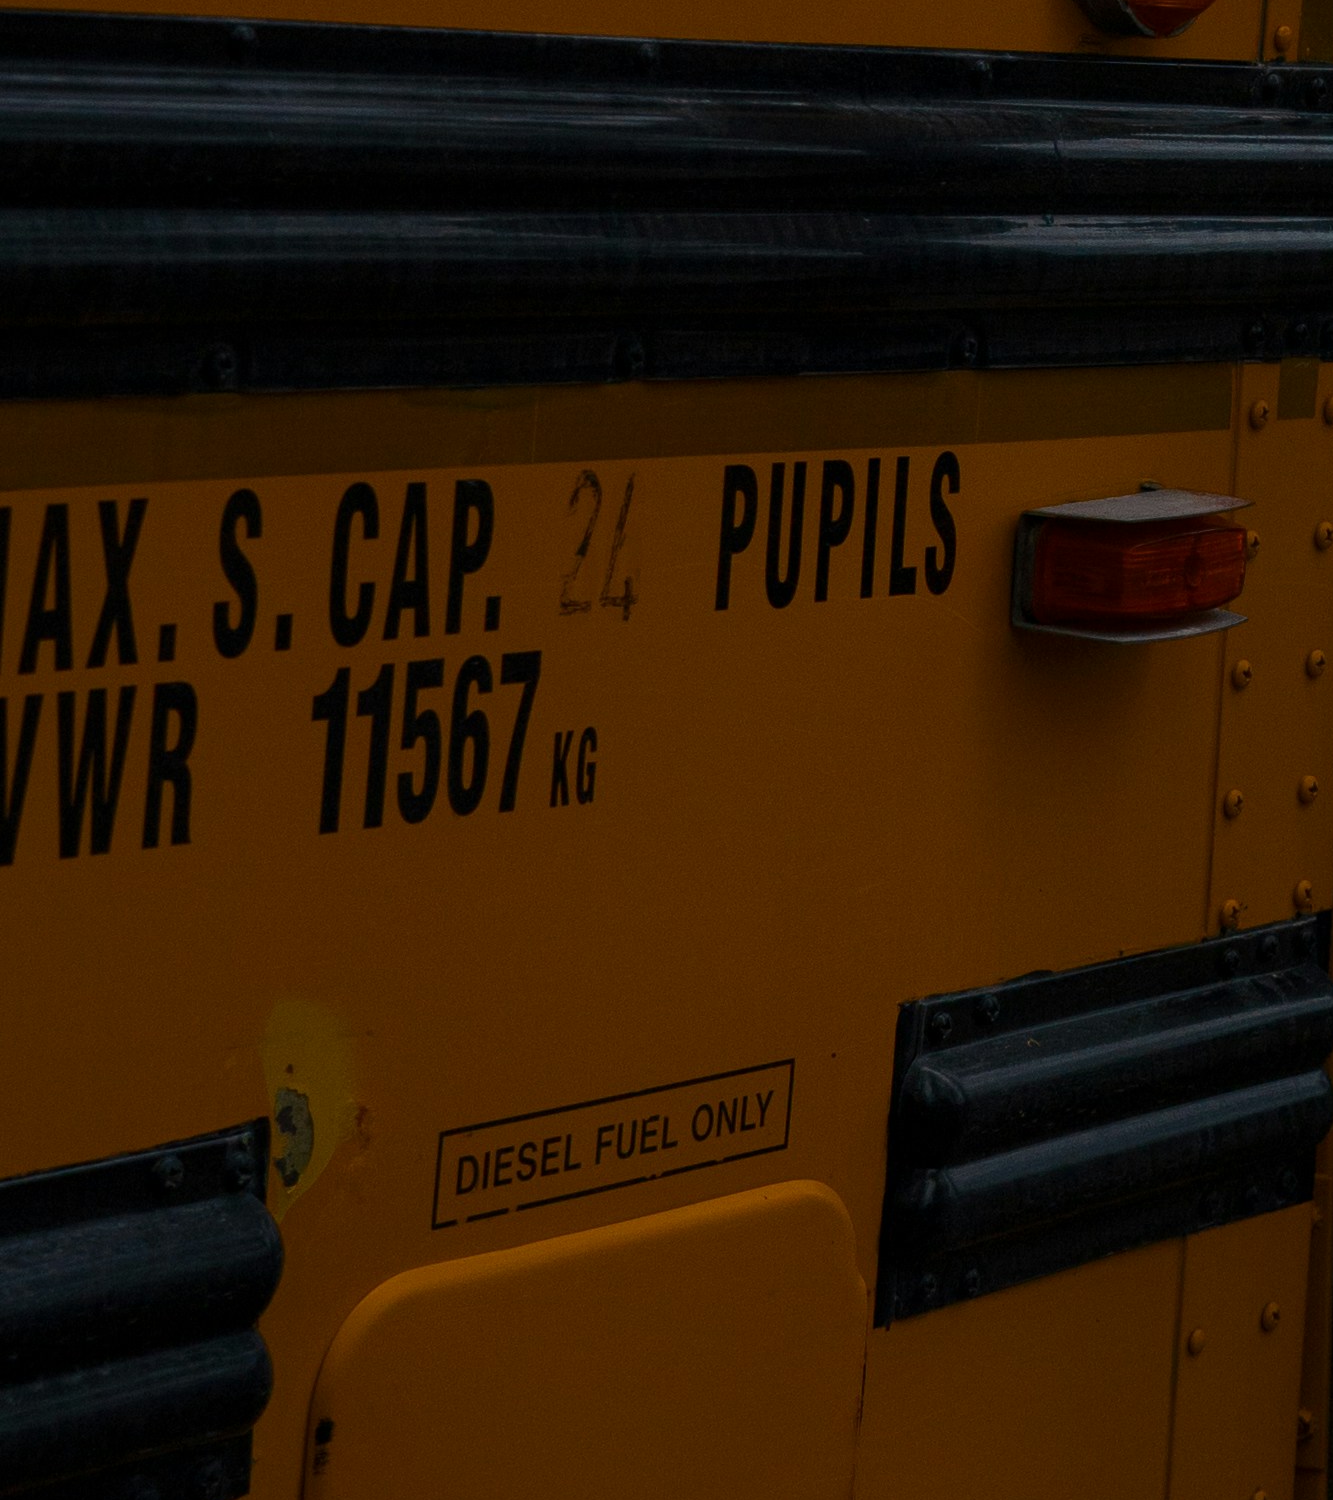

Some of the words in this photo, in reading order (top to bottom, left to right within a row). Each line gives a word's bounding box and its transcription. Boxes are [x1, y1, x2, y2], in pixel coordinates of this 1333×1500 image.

[0, 498, 177, 674] AX.
[213, 487, 293, 659] S.
[328, 478, 502, 648] CAP.
[559, 467, 638, 622] 24
[715, 451, 961, 611] PUPILS
[311, 650, 542, 836] 11567
[550, 726, 599, 810] KG
[456, 1133, 582, 1196] DIESEL
[595, 1114, 679, 1165] FUEL
[691, 1090, 774, 1143] ONLY
